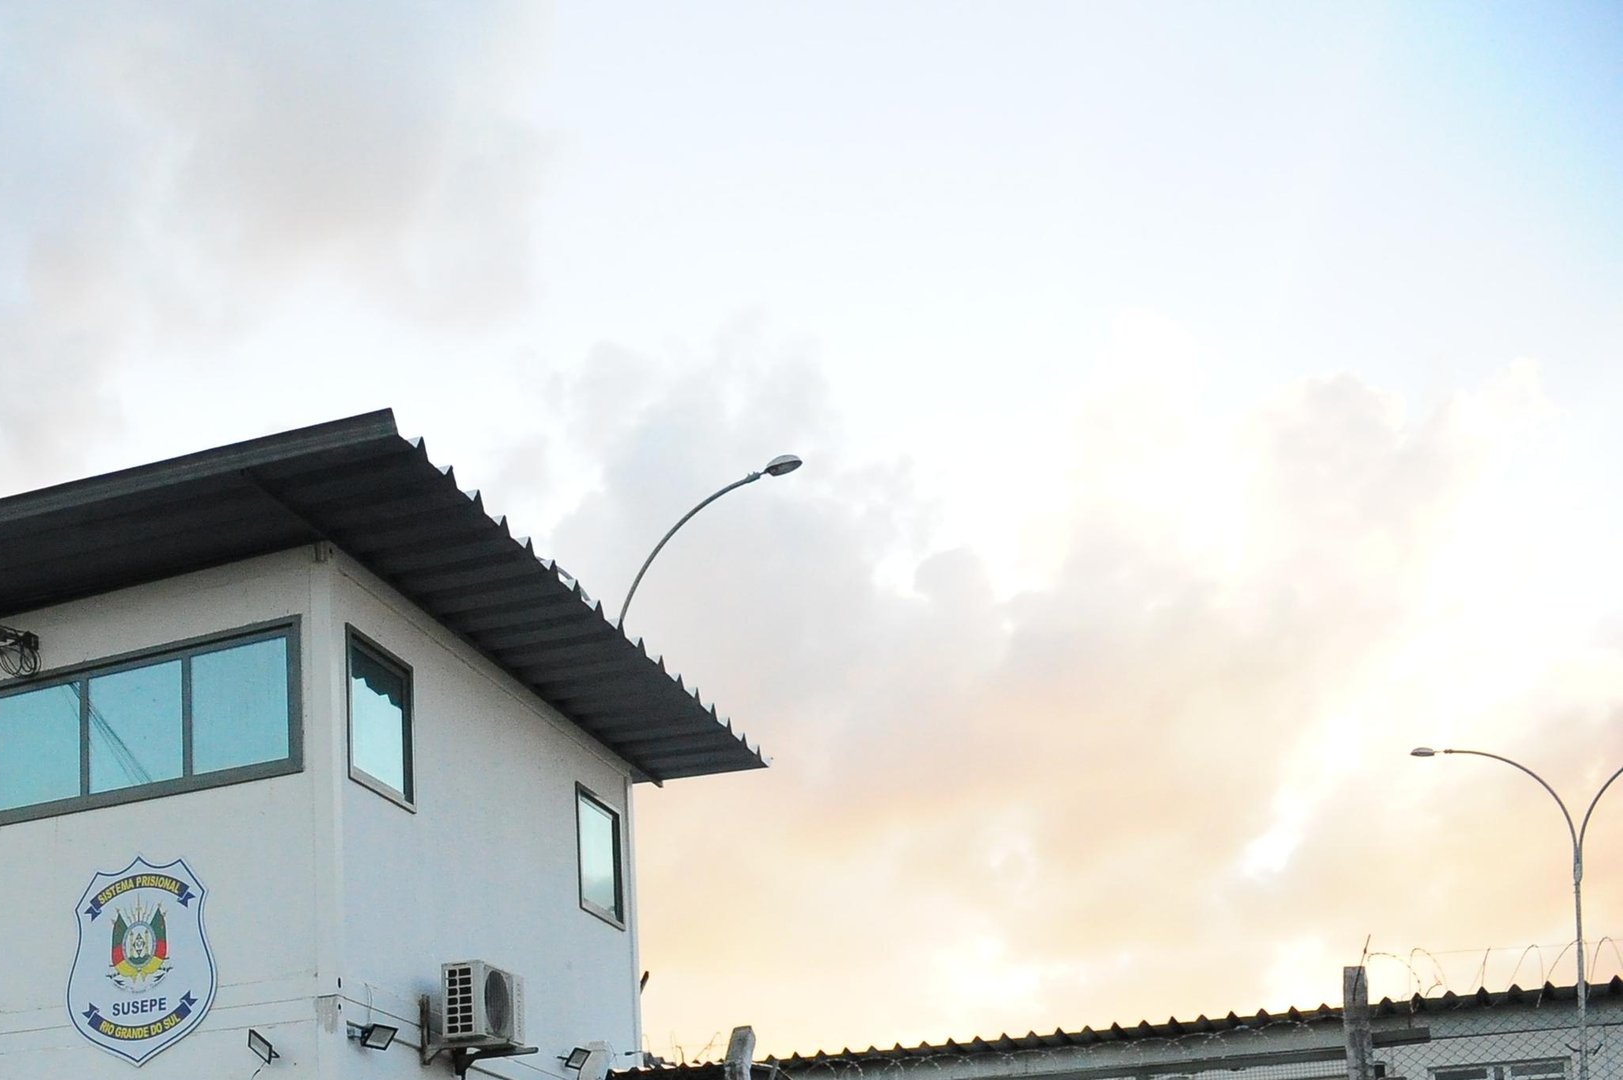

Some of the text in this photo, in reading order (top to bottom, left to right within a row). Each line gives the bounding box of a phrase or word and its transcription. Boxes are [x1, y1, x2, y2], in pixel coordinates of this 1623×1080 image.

[97, 875, 180, 904] SISTEMA PRISIONAL
[112, 997, 167, 1016] SUSEPE
[99, 1013, 181, 1039] RIO GRANDE DO SUL
